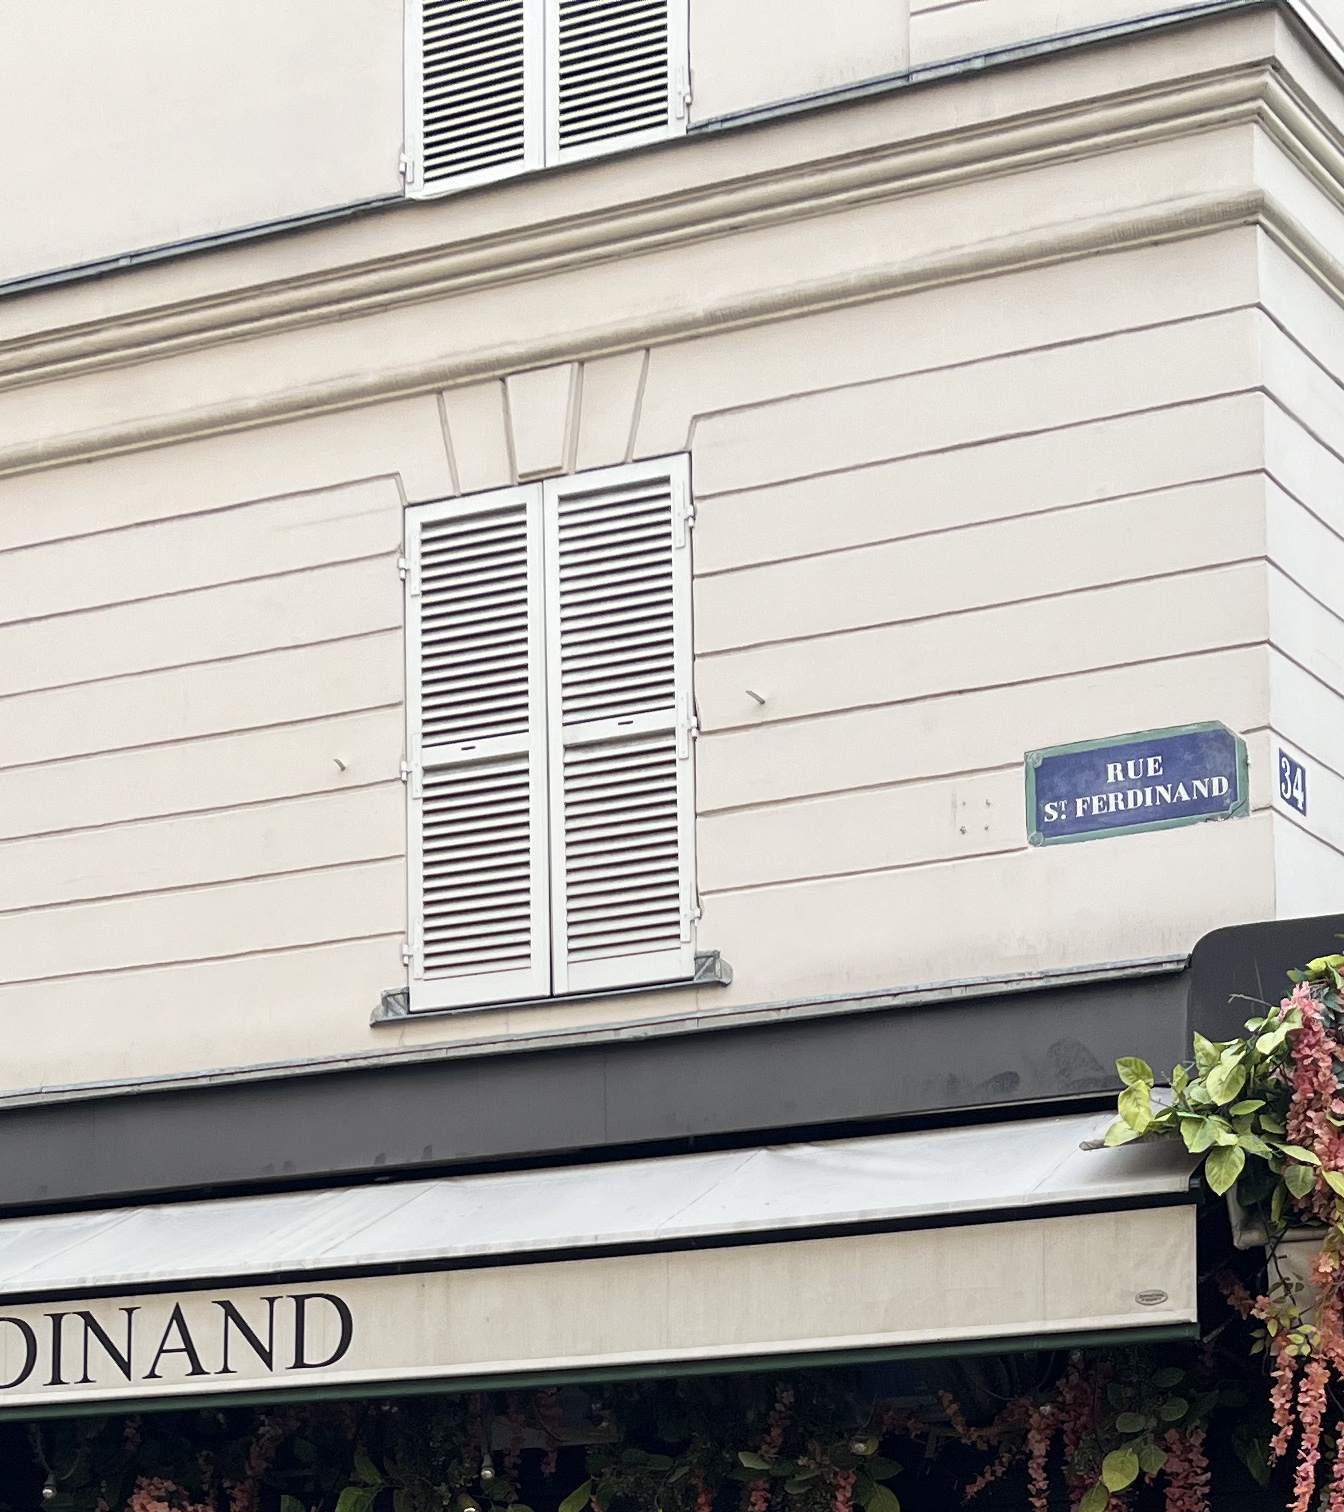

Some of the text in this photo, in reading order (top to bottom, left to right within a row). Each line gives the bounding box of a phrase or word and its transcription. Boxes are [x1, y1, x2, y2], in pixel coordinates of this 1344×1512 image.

[1106, 755, 1163, 783] RUE
[1280, 757, 1305, 811] 34
[1075, 776, 1229, 818] FERDINAND
